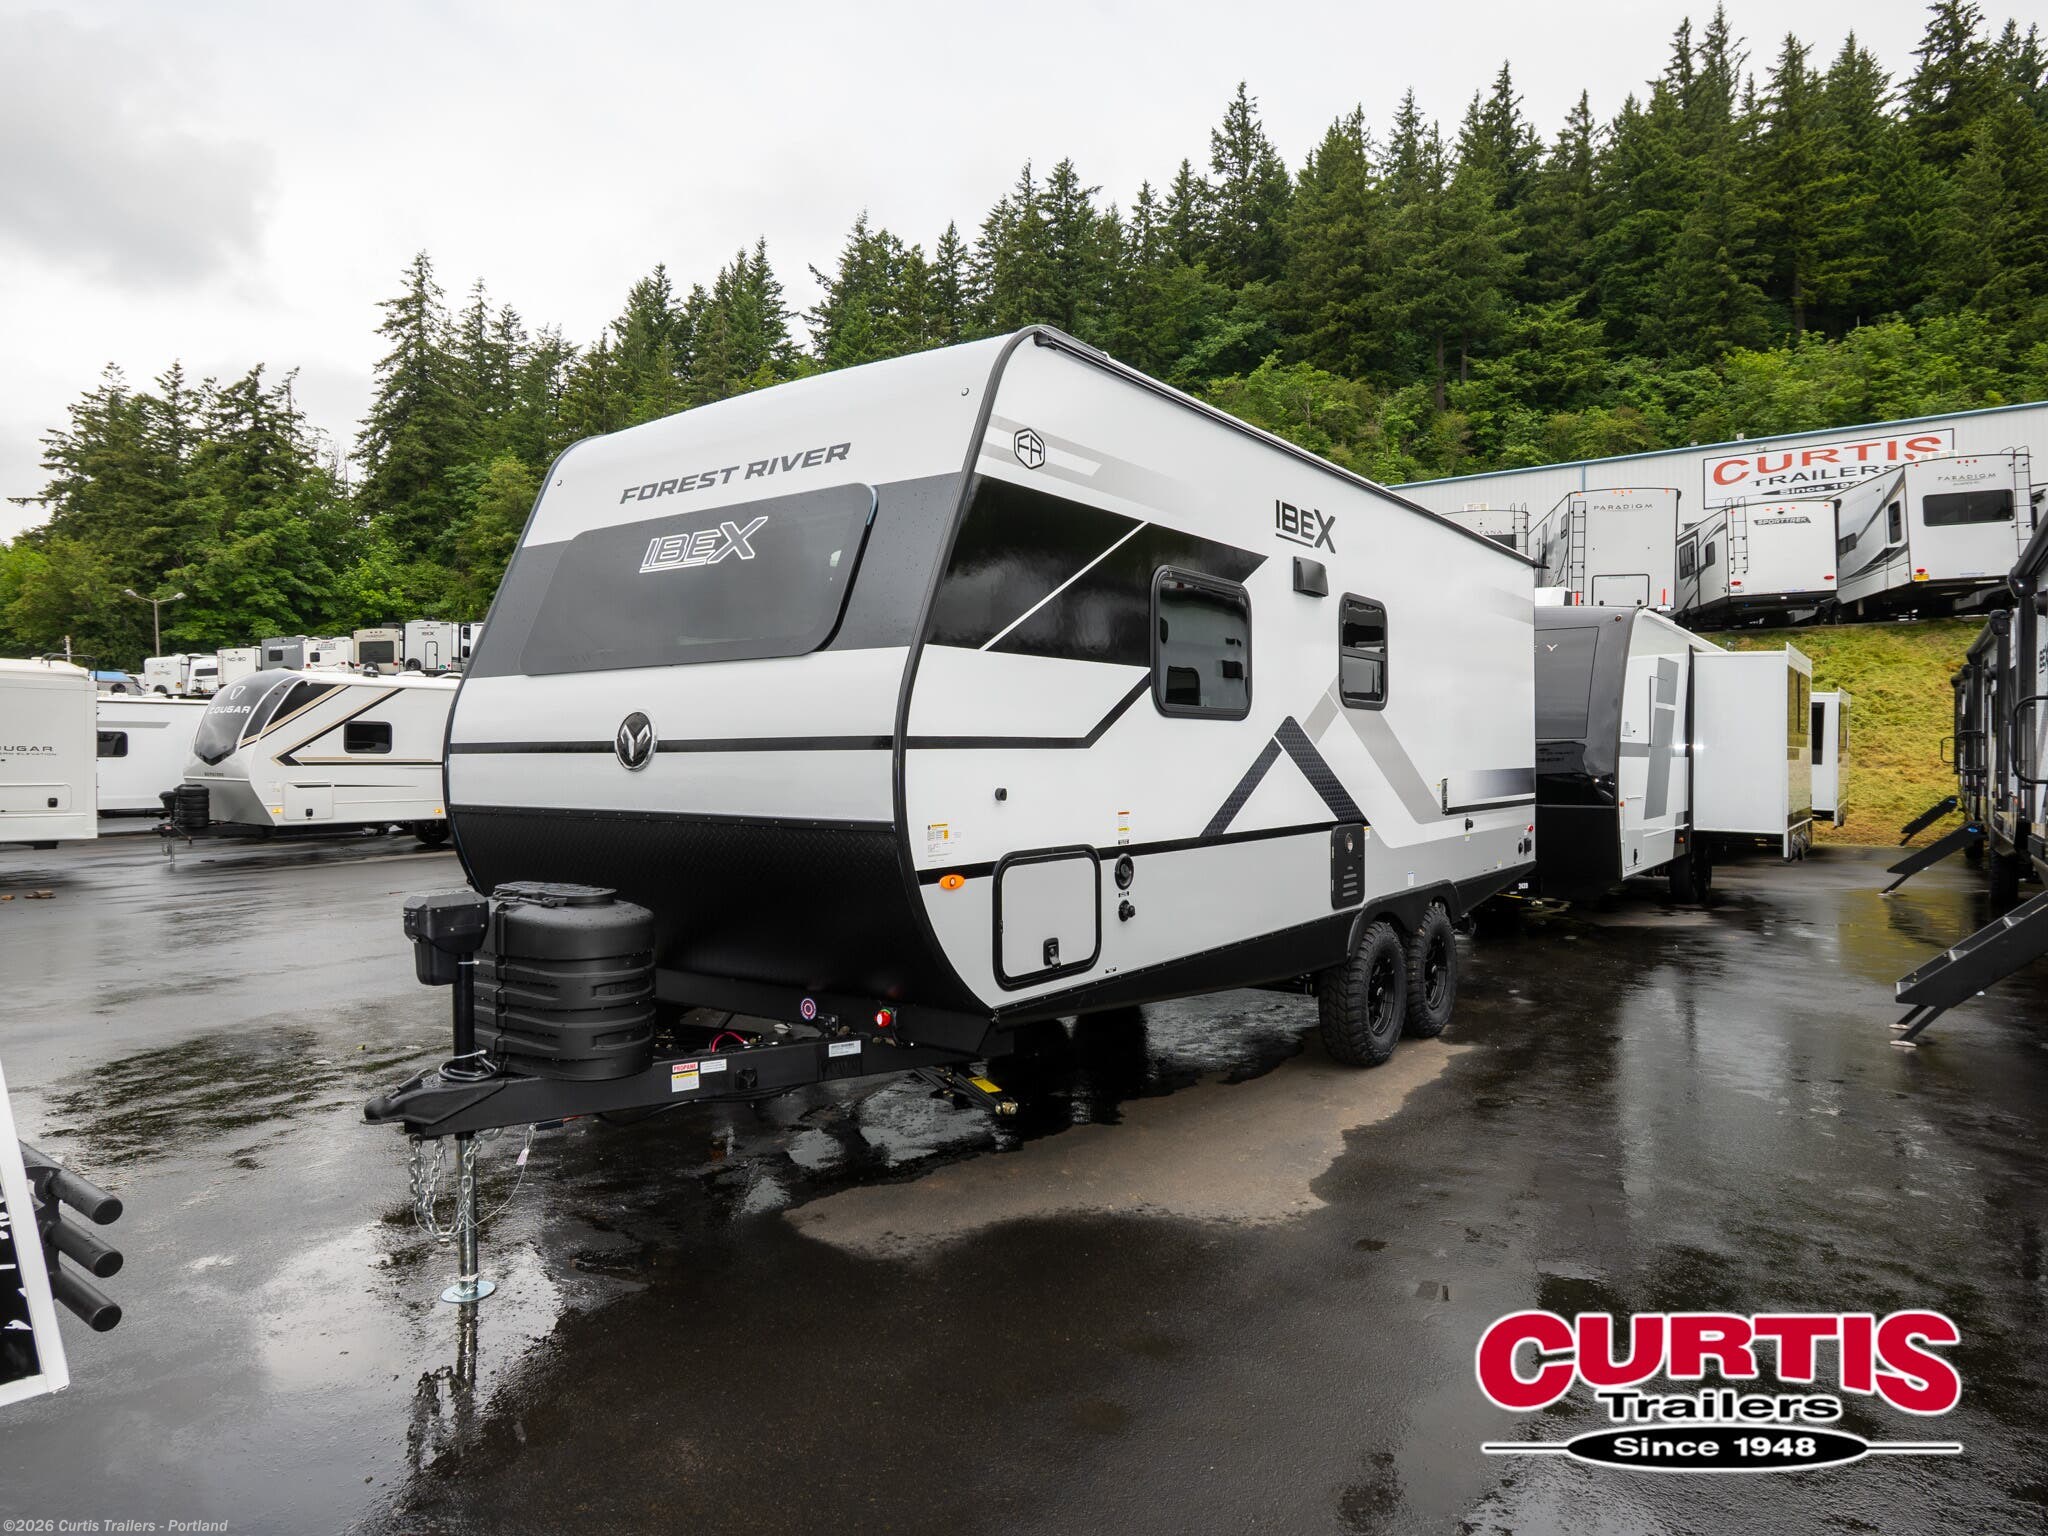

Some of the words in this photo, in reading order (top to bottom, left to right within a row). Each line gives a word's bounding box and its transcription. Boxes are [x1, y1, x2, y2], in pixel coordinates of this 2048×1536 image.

[1712, 436, 1943, 486] CURTIS
[619, 466, 740, 505] FOREST
[744, 441, 852, 481] RIVER
[1750, 464, 1898, 487] TRAILERS
[1937, 472, 1997, 481] PARADIGM
[1779, 484, 1827, 496] Since
[1593, 503, 1654, 511] PARADIGM
[1275, 498, 1336, 555] IBEX
[1757, 516, 1808, 526] SPORTTREK
[640, 515, 769, 573] IBEX
[208, 705, 252, 715] COUGAR
[673, 1063, 697, 1072] PROPANE
